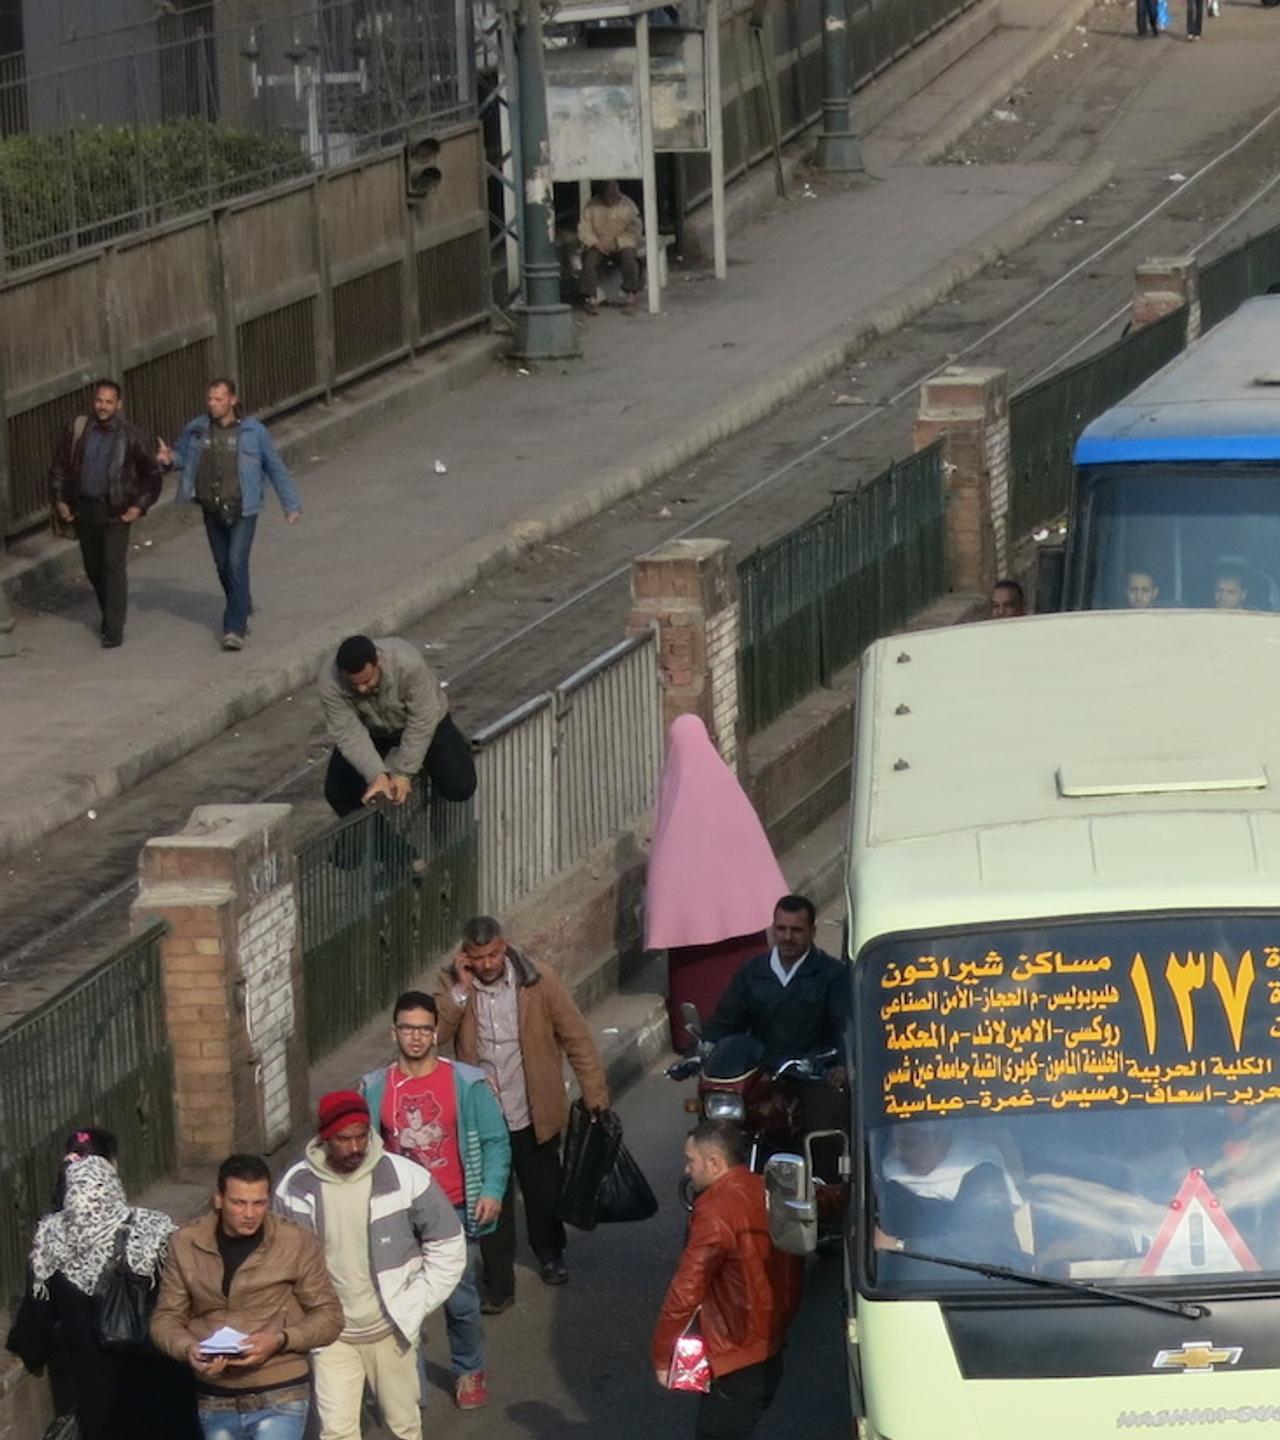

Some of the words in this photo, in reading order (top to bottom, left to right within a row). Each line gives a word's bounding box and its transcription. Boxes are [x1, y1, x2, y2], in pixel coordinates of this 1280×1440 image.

[880, 950, 1004, 988] شيراتون
[1011, 950, 1113, 981] مساكن
[1129, 951, 1257, 1054] ١٣٧
[885, 1020, 946, 1051] المحكمة
[882, 1055, 911, 1091] شمس
[912, 1058, 934, 1090] عين
[1081, 1047, 1125, 1081] الخليفة
[1124, 1058, 1206, 1083] الحربية
[1211, 1055, 1273, 1082] الكلية
